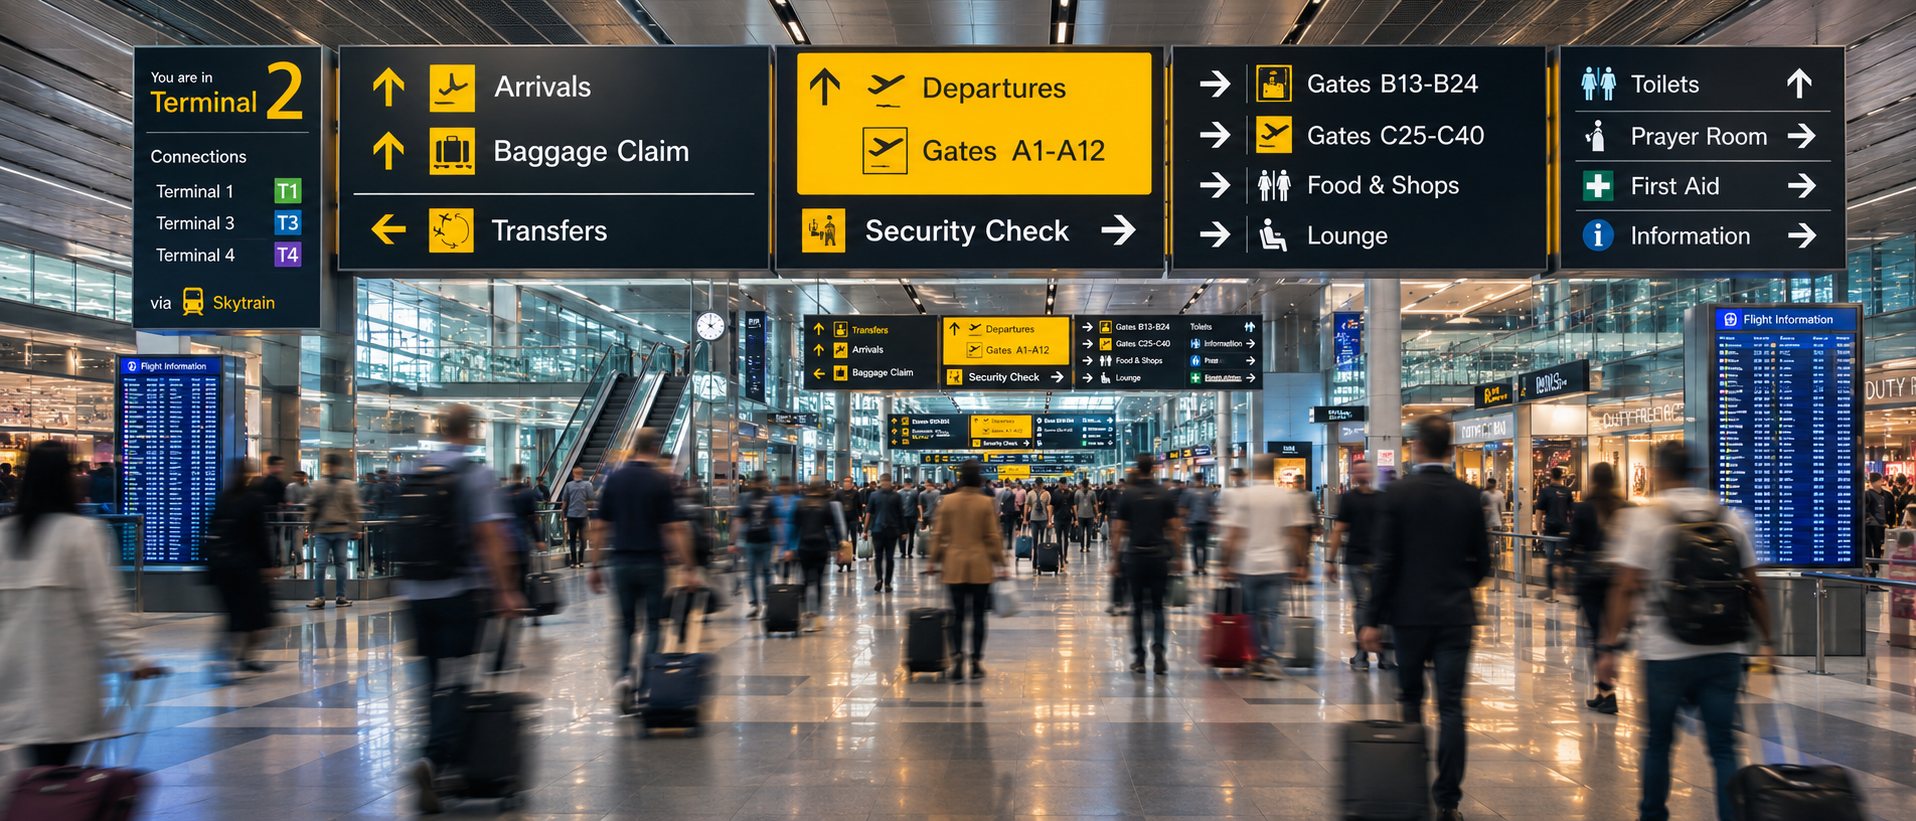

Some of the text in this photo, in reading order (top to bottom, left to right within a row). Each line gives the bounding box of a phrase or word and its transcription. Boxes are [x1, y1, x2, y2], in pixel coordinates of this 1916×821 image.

[151, 72, 212, 83] You are in
[1308, 74, 1478, 93] Gates B13-B24
[1631, 75, 1699, 93] Toilets
[267, 61, 302, 119] 2
[495, 75, 591, 97] Arrivals
[924, 77, 1066, 104] Departures
[150, 91, 256, 112] Terminal
[1308, 126, 1484, 145] Gates C25-C40
[1632, 127, 1767, 149] Prayer Room
[151, 150, 246, 163] Connections
[495, 140, 688, 167] Baggage Claim
[923, 140, 1104, 161] Gates A1-A12
[156, 184, 232, 198] Terminal 1
[277, 183, 296, 198] T1
[1309, 175, 1459, 198] Food & Shops
[1632, 177, 1719, 195] First Aid
[156, 216, 234, 230] Terminal 3
[277, 215, 298, 230] T3
[492, 219, 607, 241] Transfers
[866, 219, 1069, 247] Security Check
[1309, 226, 1388, 249] Lounge
[1632, 226, 1750, 244] Information
[156, 248, 235, 262] Terminal 4
[277, 247, 298, 262] T4
[151, 296, 171, 309] via
[214, 296, 274, 312] Skytrain
[1744, 314, 1834, 326] Flight Information
[852, 326, 888, 334] Transfers
[986, 324, 1034, 334] Departures
[852, 346, 884, 354] Arrivals
[986, 346, 1050, 354] Gates A1-A12
[1141, 357, 1163, 366] Shops
[852, 368, 914, 378] Baggage Claim
[968, 372, 1040, 384] Security Check
[1116, 374, 1142, 382] Lounge
[1865, 377, 1905, 400] DUTY
